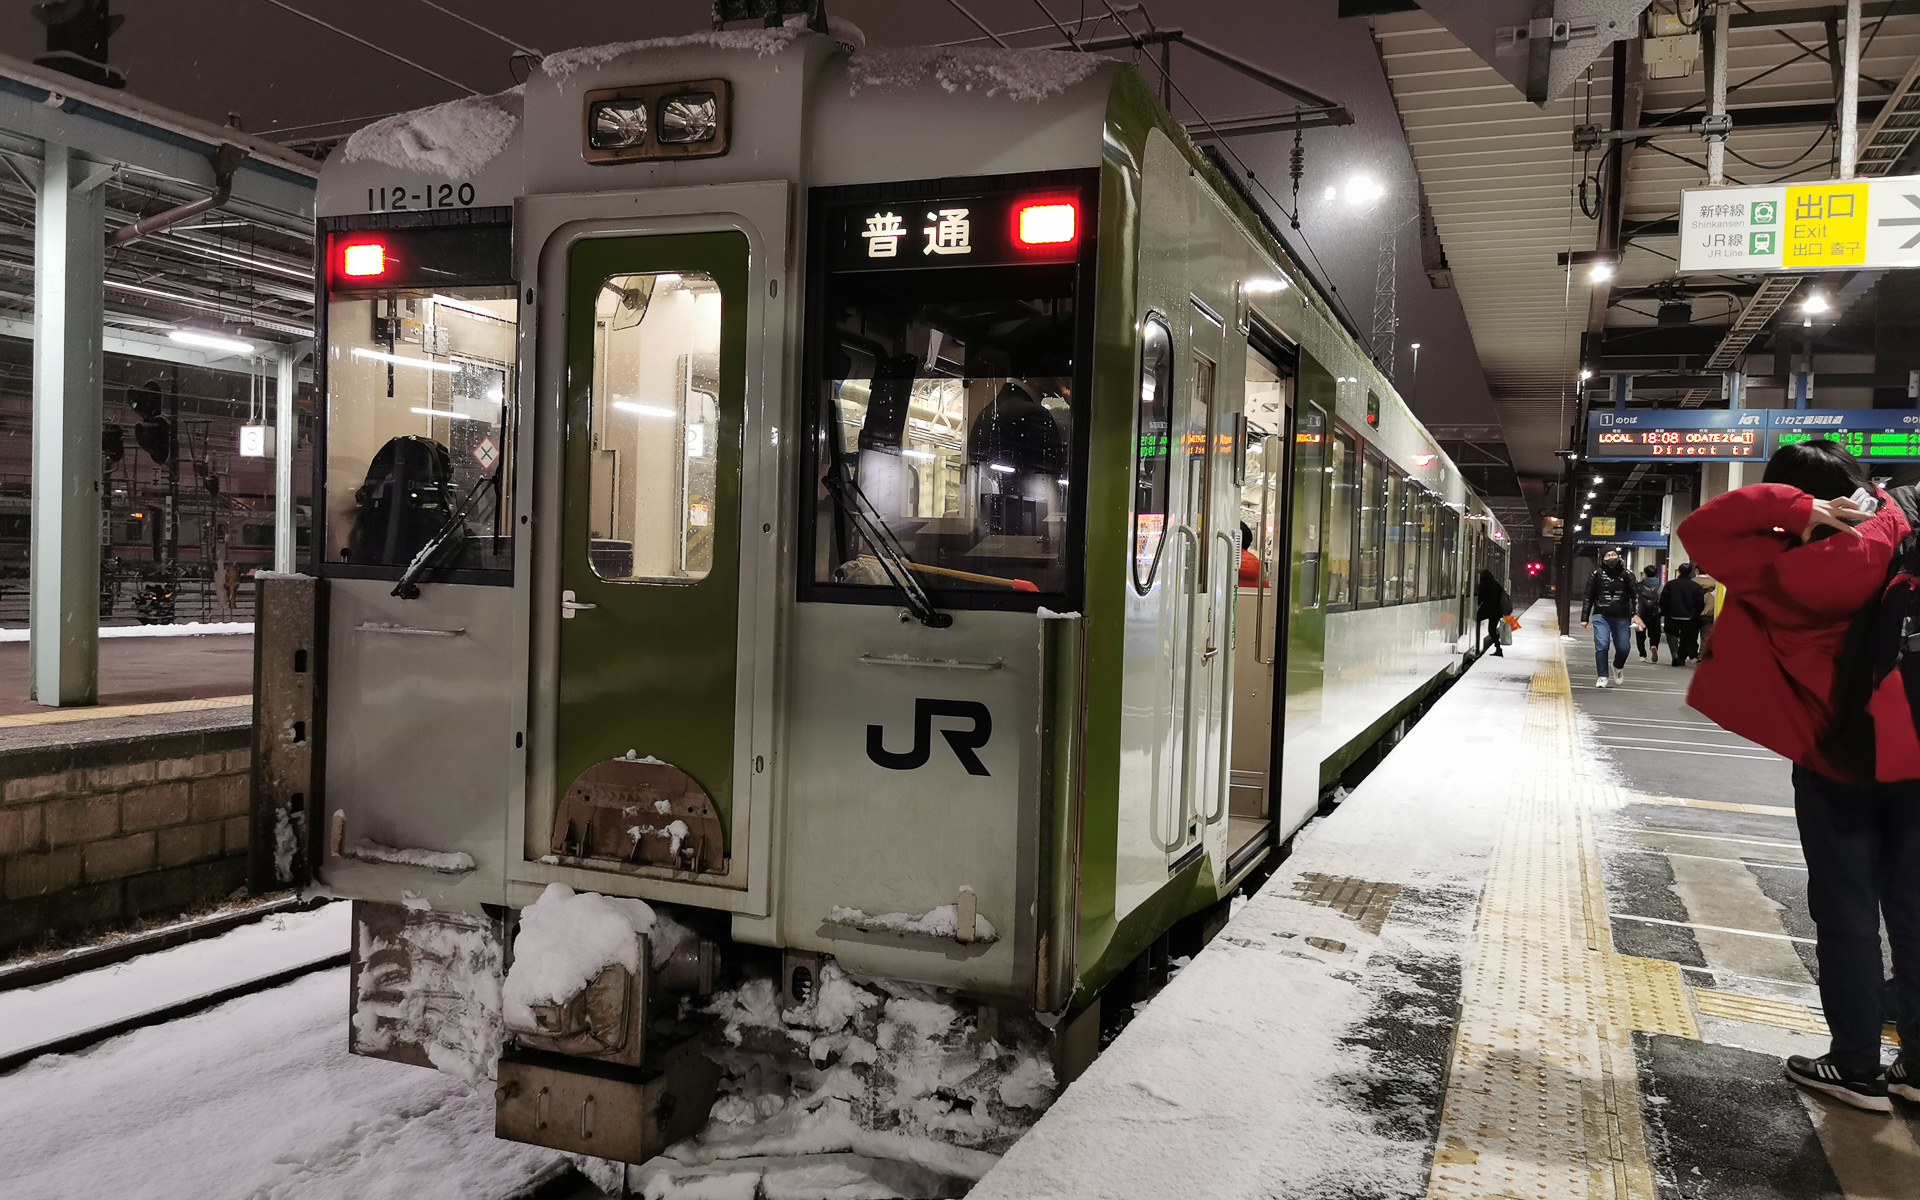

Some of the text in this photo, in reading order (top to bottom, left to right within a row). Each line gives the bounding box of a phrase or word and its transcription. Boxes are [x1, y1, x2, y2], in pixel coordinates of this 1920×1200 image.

[368, 183, 476, 211] 112-120
[1699, 204, 1745, 218] 新幹線
[1795, 194, 1855, 220] 出口
[1691, 221, 1745, 229] Shinkansen
[1794, 224, 1828, 239] Exit
[861, 208, 972, 258] 普通
[1702, 234, 1743, 247] JR線
[1708, 249, 1743, 258] JR Line
[1793, 243, 1822, 256] 出口
[1615, 416, 1638, 424] のりば
[247, 431, 258, 451] 3
[1599, 433, 1634, 443] LOCAL
[1641, 432, 1679, 444] 18:08
[1652, 445, 1751, 455] Direct tr
[866, 698, 993, 777] JR
